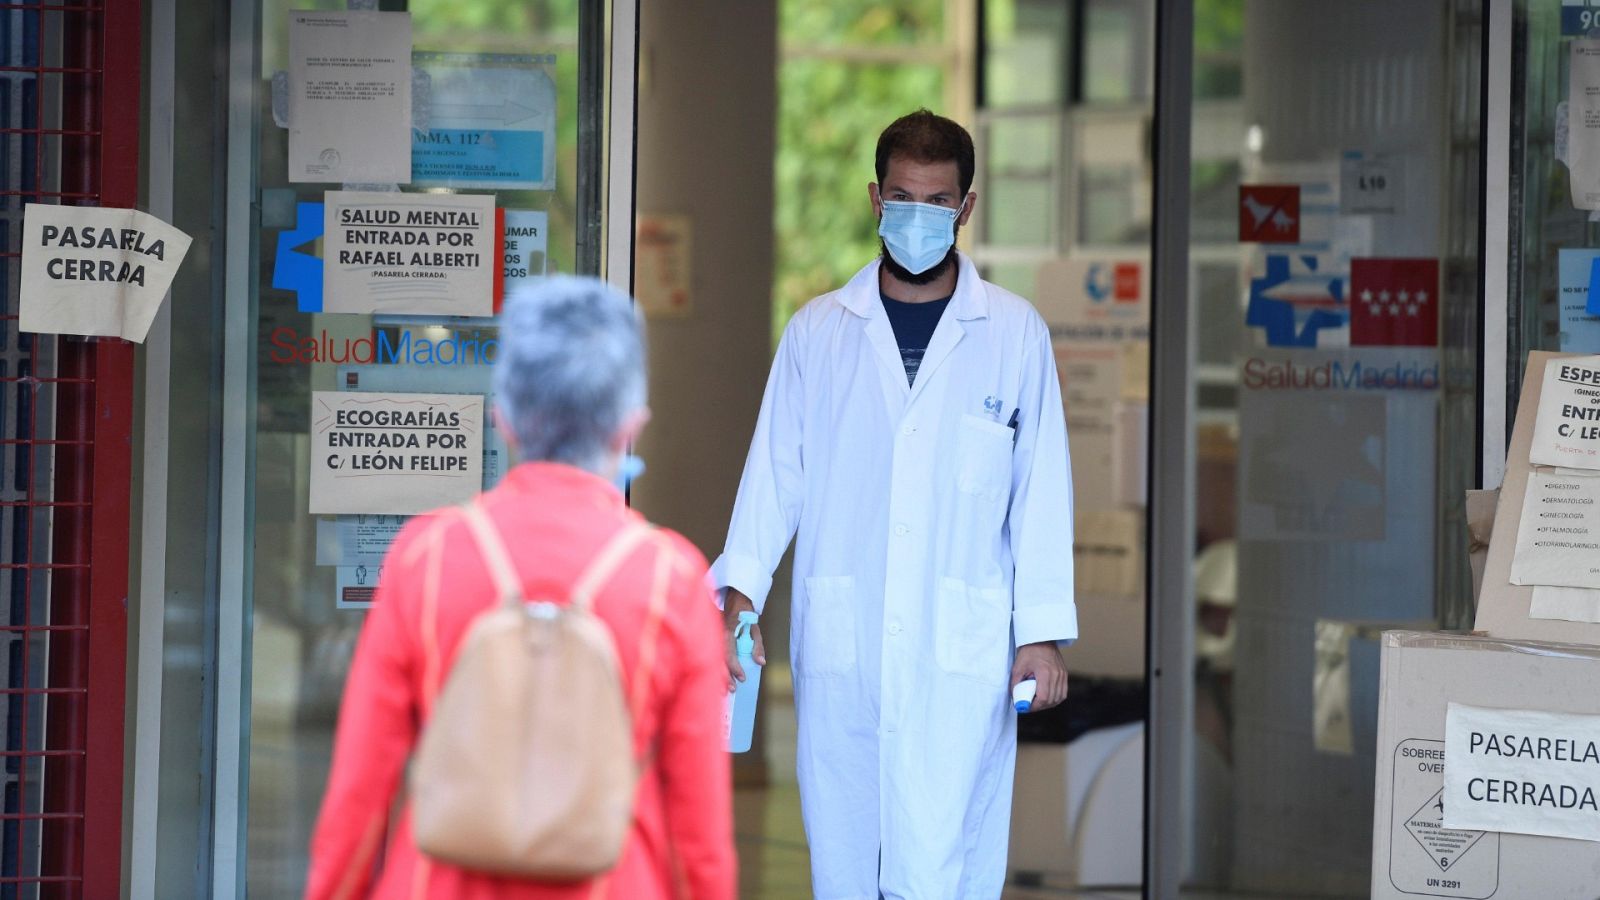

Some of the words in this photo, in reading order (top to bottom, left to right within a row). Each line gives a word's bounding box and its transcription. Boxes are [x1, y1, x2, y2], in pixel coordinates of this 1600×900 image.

[460, 133, 480, 145] 112
[1359, 176, 1386, 191] L10
[341, 209, 401, 224] SALUD
[406, 211, 479, 226] MENTAL
[41, 225, 165, 262] PASARELA
[346, 230, 430, 246] ENTRADA
[436, 232, 474, 247] POR
[339, 251, 405, 266] RAFAEL
[410, 252, 480, 267] ALBERTI
[371, 270, 410, 278] (PASARELA
[411, 271, 447, 279] CERRADA)
[1243, 357, 1440, 390] SaludMadrid
[1560, 365, 1600, 384] ESPE
[336, 407, 460, 427] ECOGRAFÍAS
[1557, 423, 1575, 438] C/
[1580, 426, 1600, 440] LE
[328, 432, 420, 449] ENTRADA
[426, 433, 467, 449] POR
[326, 454, 346, 470] C/
[351, 450, 404, 470] LEÓN
[410, 456, 468, 471] FELIPE
[1402, 747, 1445, 760] SOBREE
[1470, 731, 1600, 764] PASARELA
[1467, 777, 1598, 811] CERRADA
[1410, 820, 1441, 829] MATERIAS
[1440, 857, 1448, 867] 6
[1426, 878, 1440, 887] UN
[1441, 879, 1461, 889] 3291
